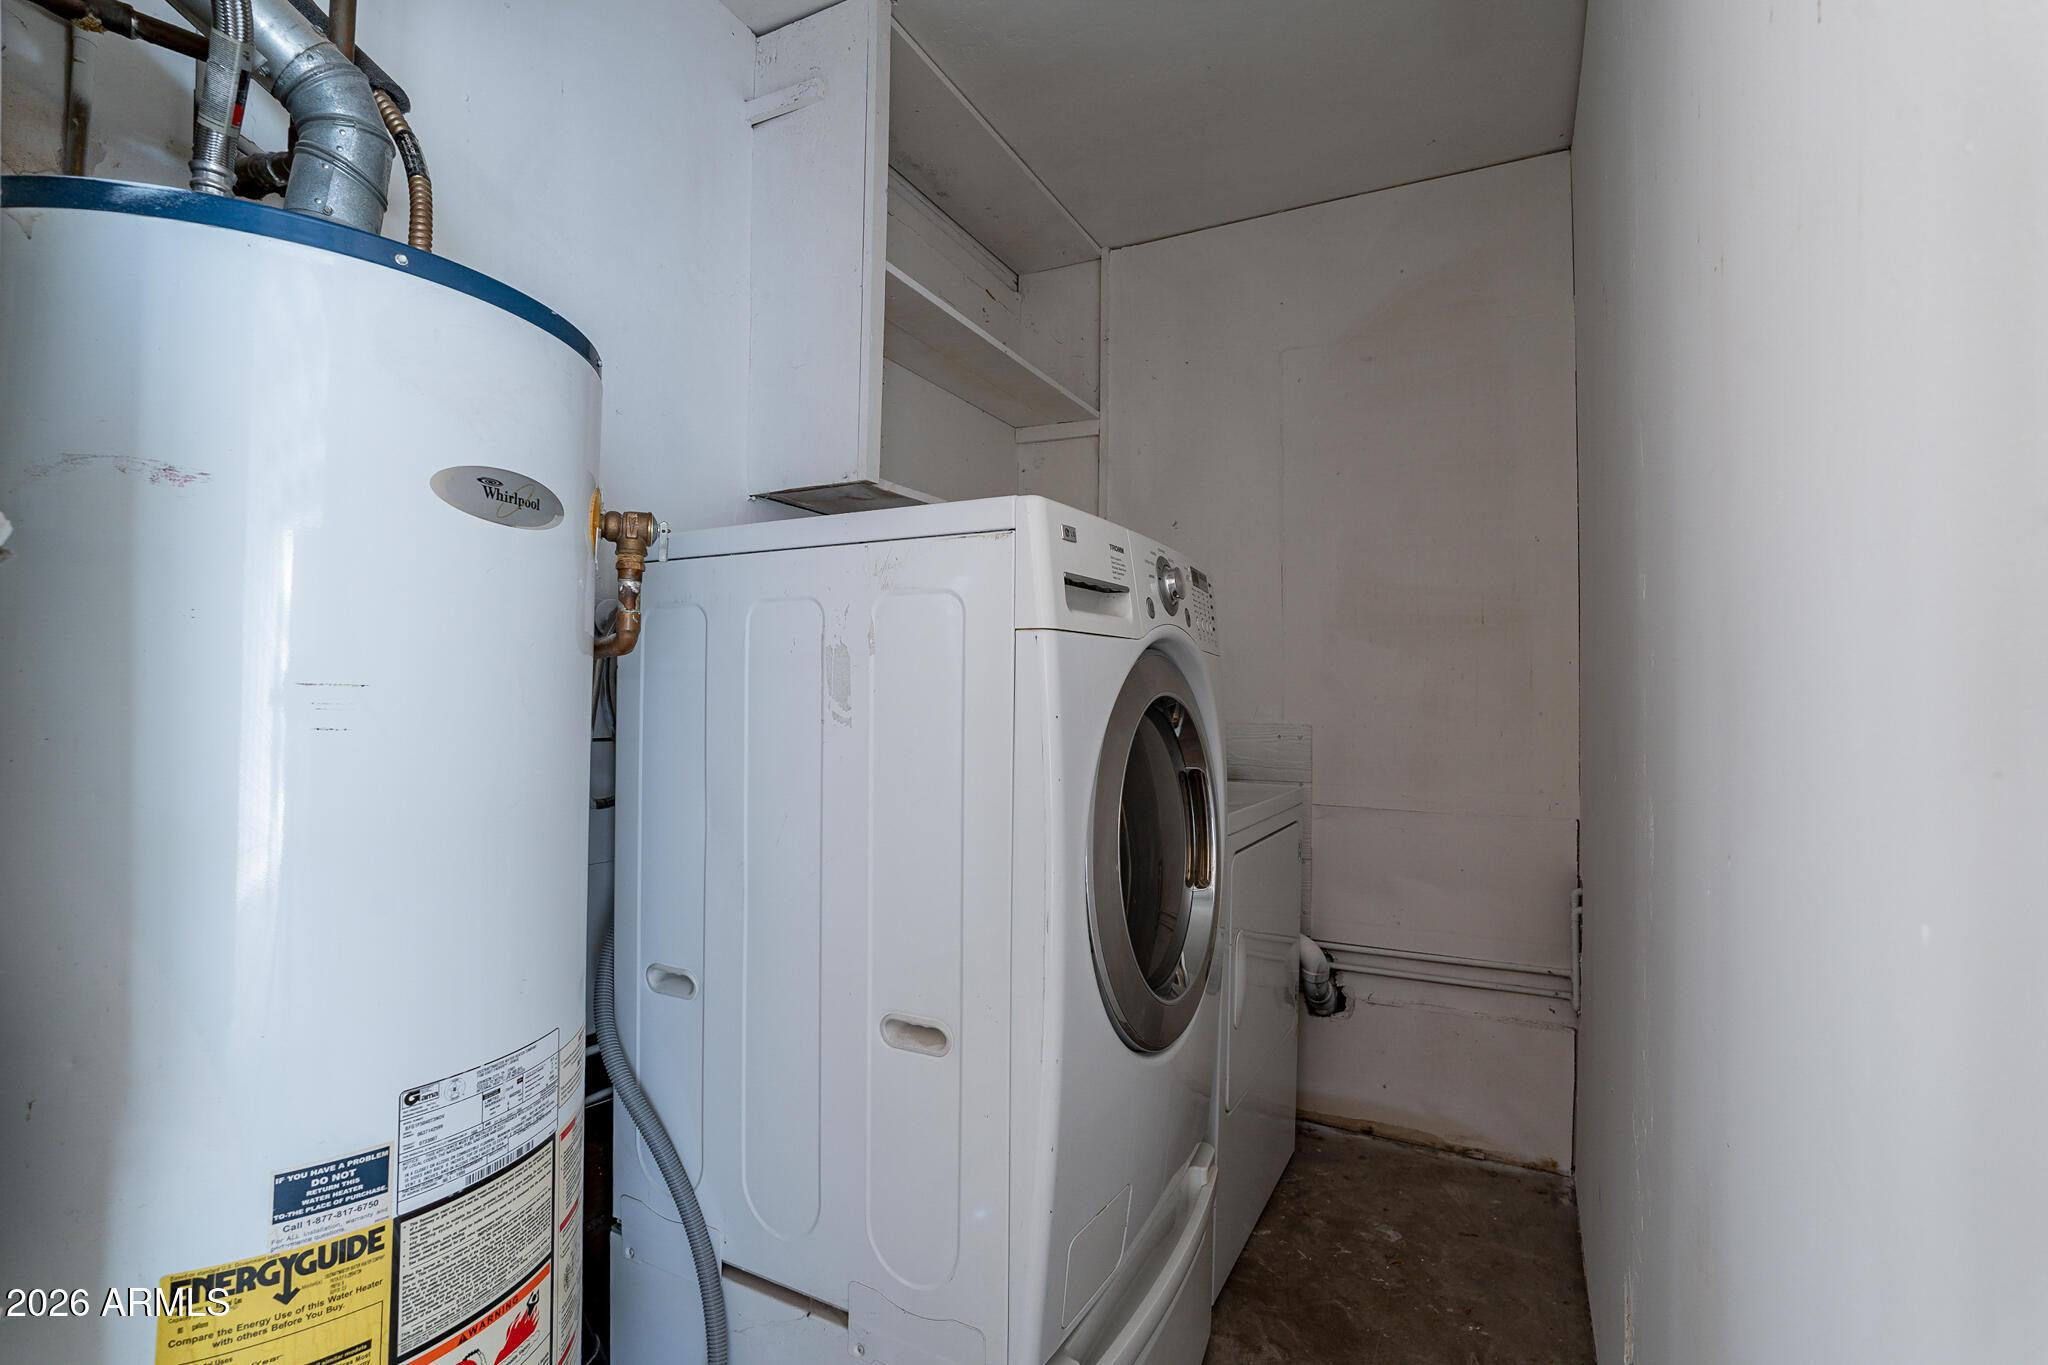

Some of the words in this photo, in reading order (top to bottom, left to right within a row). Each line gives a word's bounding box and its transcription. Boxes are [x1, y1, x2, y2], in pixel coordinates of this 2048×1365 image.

[482, 485, 540, 511] Whirlpool
[275, 1177, 285, 1185] IF
[287, 1172, 308, 1182] YOU
[310, 1164, 336, 1177] HAVE
[338, 1162, 345, 1170] A
[346, 1150, 389, 1167] PROBLEM
[311, 1176, 328, 1187] DO
[331, 1168, 357, 1182] NOT
[301, 1193, 331, 1206] WATER
[332, 1184, 364, 1198] HEATER
[306, 1183, 340, 1196] RETURN
[341, 1177, 361, 1187] THIS
[282, 1221, 303, 1233] Call
[306, 1199, 379, 1227] 1-877-817-6750
[305, 1201, 332, 1213] PLACE
[333, 1197, 344, 1205] OF
[168, 1332, 214, 1349] Compare
[217, 1326, 233, 1337] the
[236, 1317, 271, 1331] Energy
[274, 1309, 293, 1321] Use
[295, 1304, 306, 1314] of
[308, 1299, 325, 1311] this
[327, 1289, 354, 1304] Water
[355, 1279, 384, 1294] Heater
[212, 1337, 233, 1348] with
[236, 1329, 268, 1342] others
[271, 1317, 303, 1332] Before
[306, 1309, 323, 1321] You
[468, 1295, 519, 1337] WARNING
